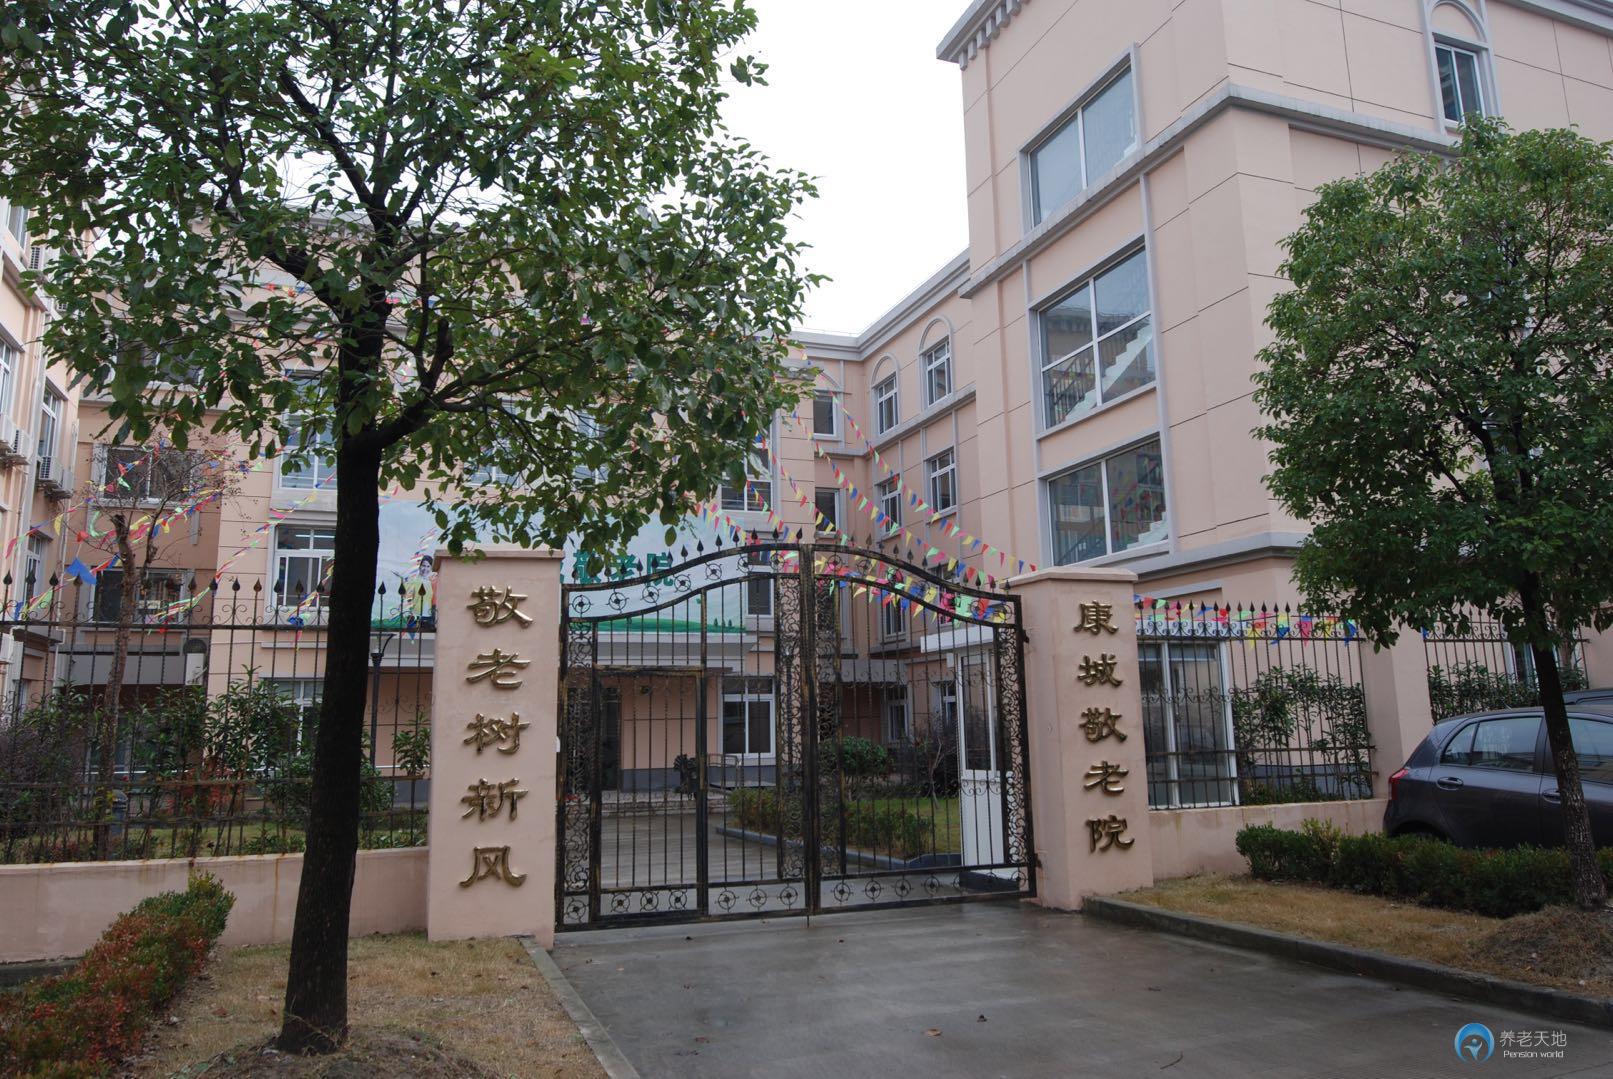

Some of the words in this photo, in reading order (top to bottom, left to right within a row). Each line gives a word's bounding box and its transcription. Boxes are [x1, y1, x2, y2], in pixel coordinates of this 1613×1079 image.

[559, 549, 674, 587] 敬老院
[460, 585, 533, 888] 敬老树新风
[1073, 600, 1135, 853] 康城敬老院
